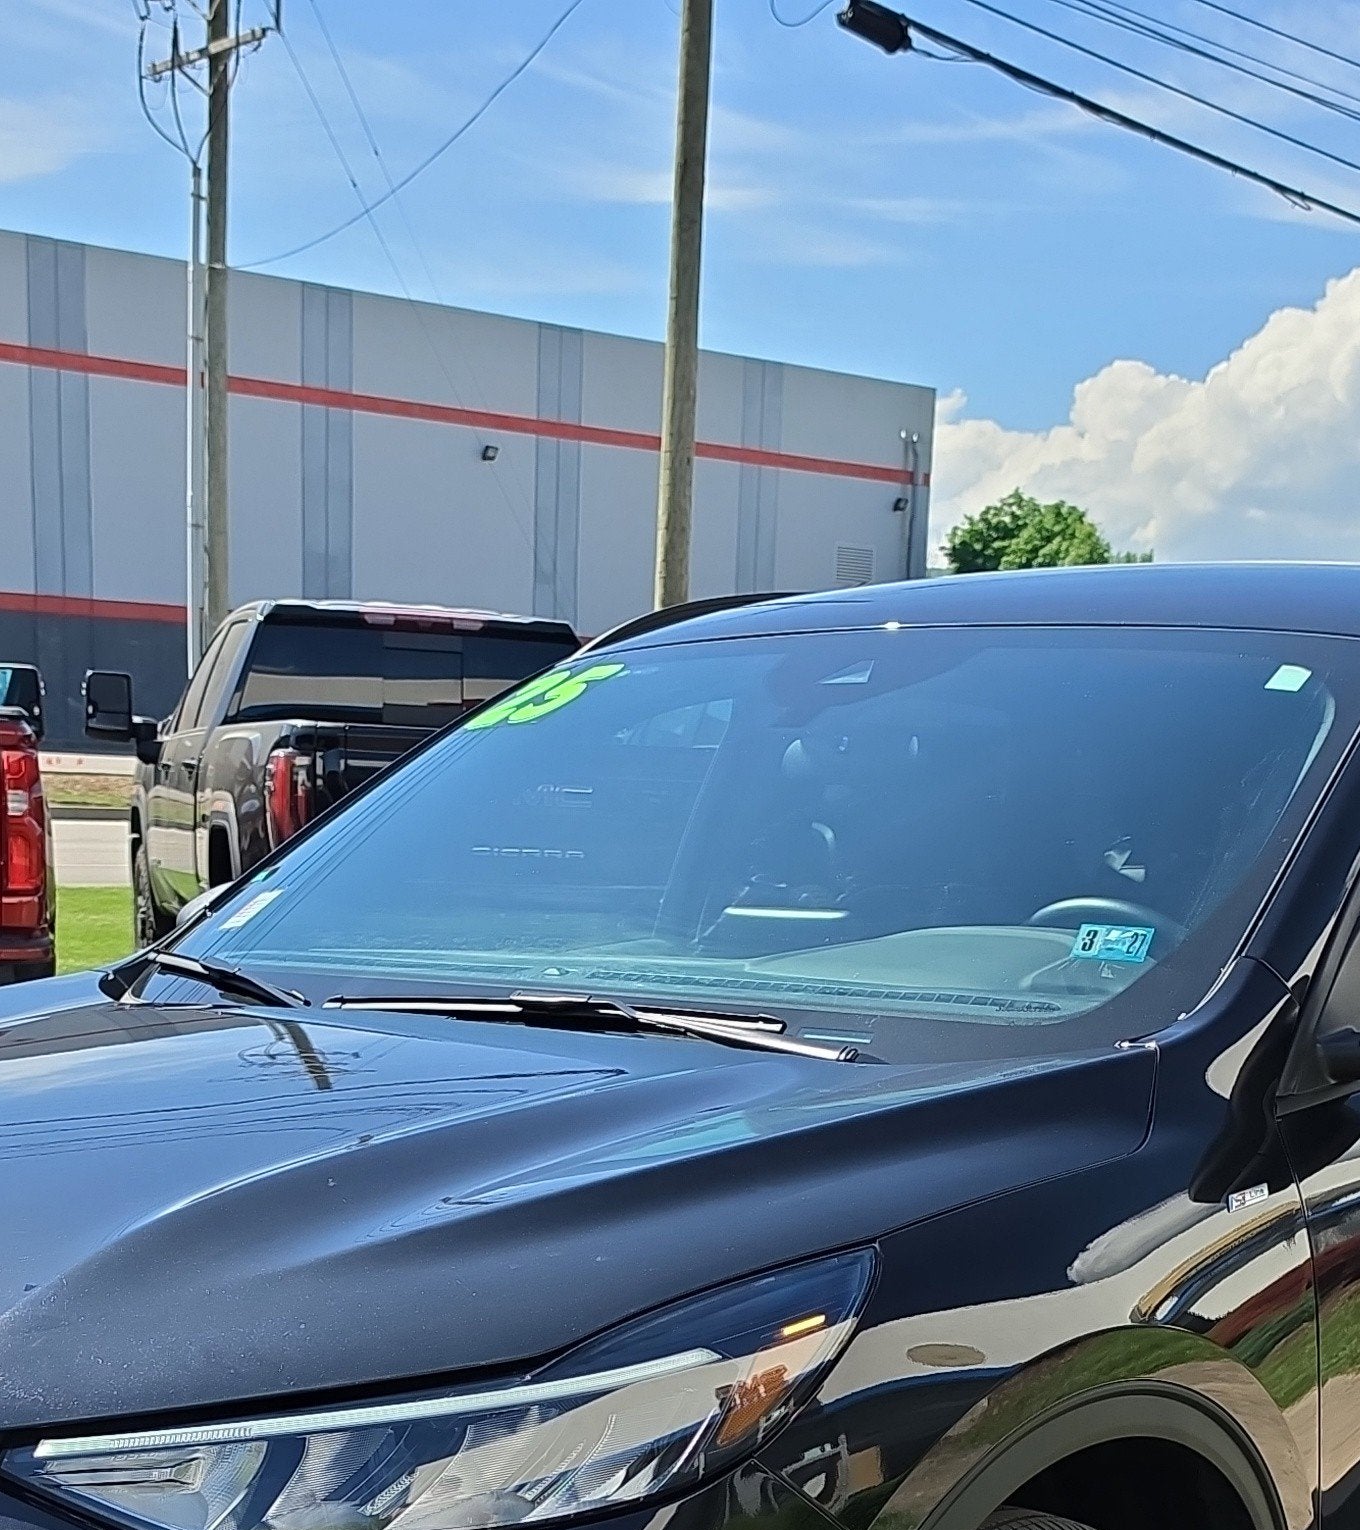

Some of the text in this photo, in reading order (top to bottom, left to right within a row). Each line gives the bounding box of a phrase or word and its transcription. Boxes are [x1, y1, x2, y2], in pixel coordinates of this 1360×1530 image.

[463, 662, 626, 731] 25
[1081, 929, 1099, 952] 3
[1125, 931, 1148, 957] 27
